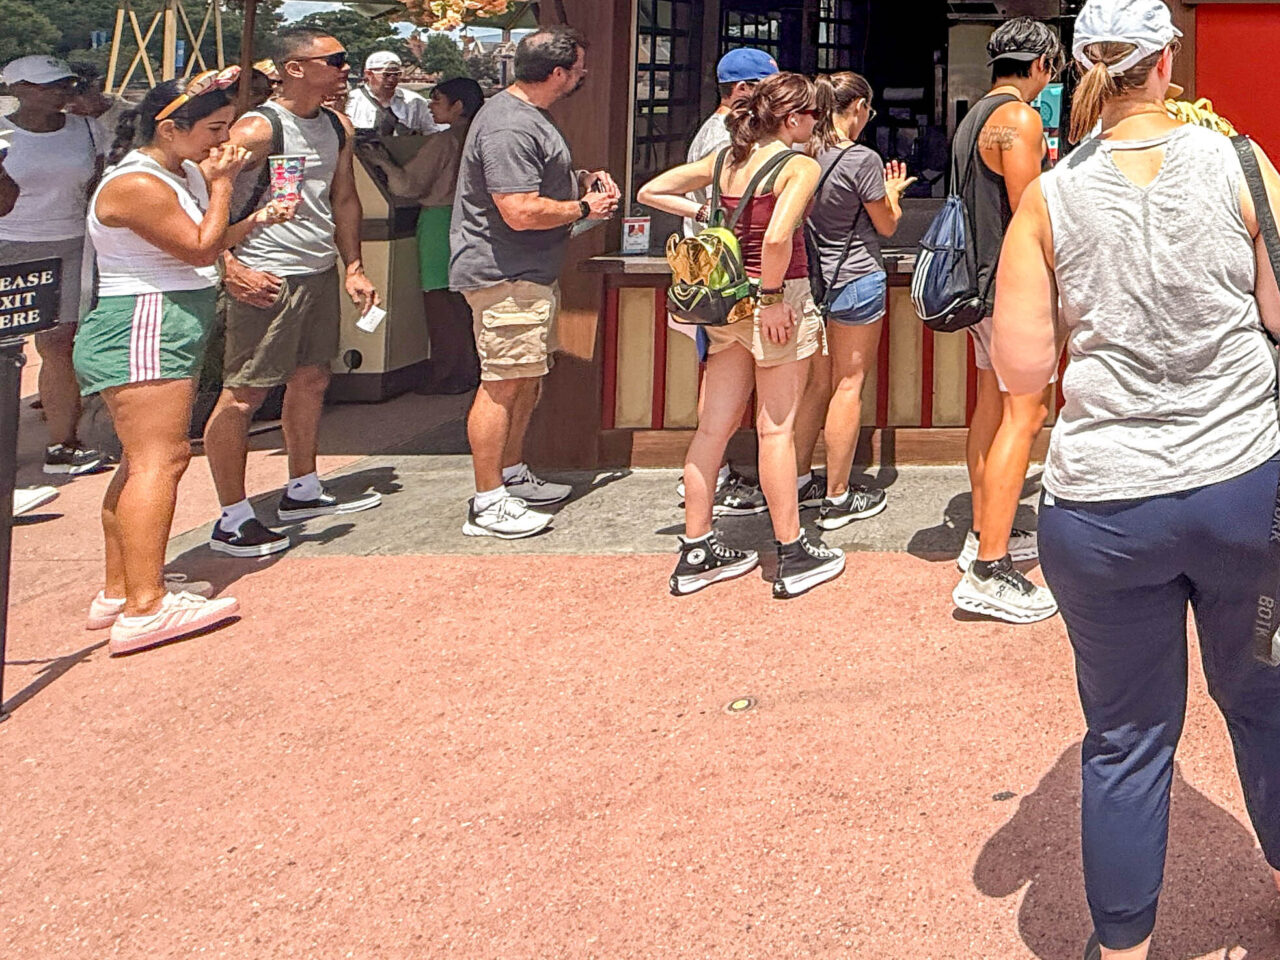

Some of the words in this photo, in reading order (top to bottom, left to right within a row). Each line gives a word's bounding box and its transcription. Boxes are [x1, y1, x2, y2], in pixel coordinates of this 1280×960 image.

[0, 270, 54, 292] EASE
[0, 291, 36, 311] XIT
[0, 309, 40, 329] ERE
